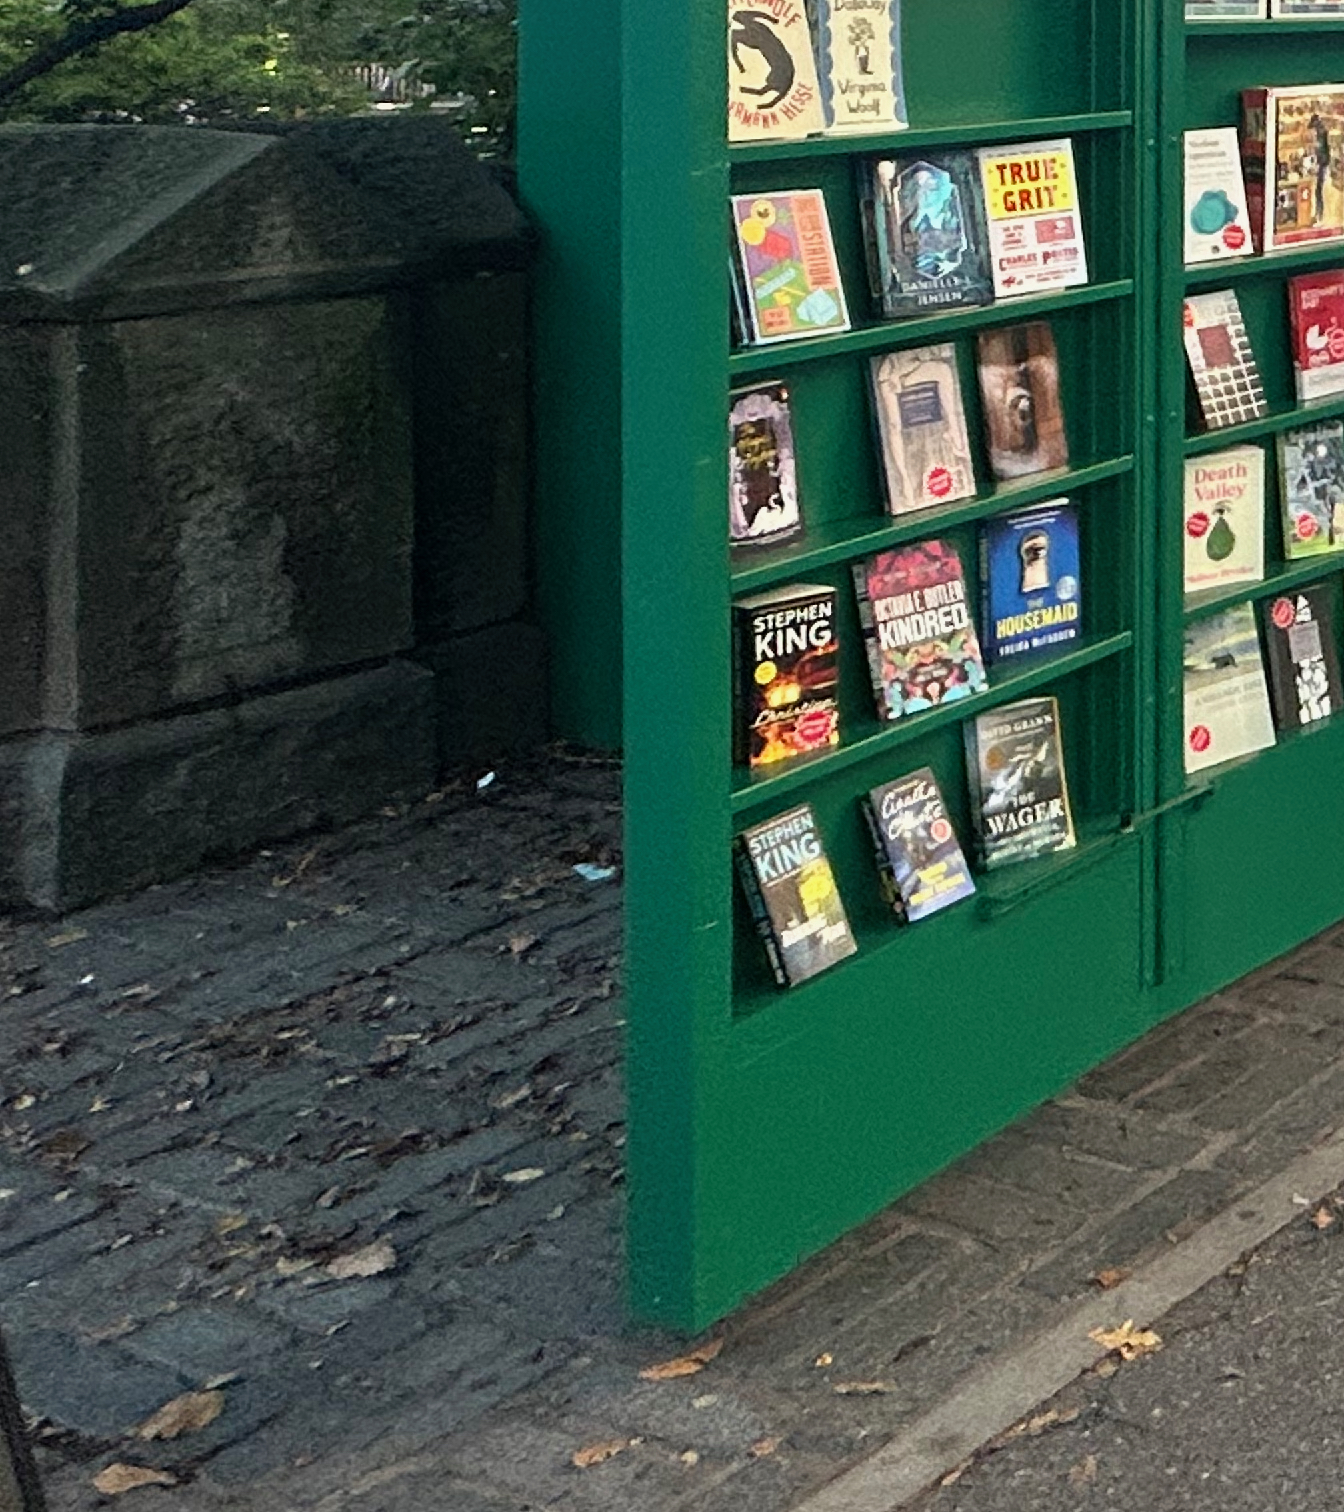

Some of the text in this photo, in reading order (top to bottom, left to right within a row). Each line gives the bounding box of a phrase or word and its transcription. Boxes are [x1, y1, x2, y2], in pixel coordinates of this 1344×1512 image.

[836, 78, 888, 98] Virginia
[846, 97, 881, 117] Woolf
[995, 156, 1059, 186] TRUE
[1002, 184, 1059, 213] GRIT
[1194, 462, 1248, 484] Death
[1194, 482, 1248, 501] Valley
[752, 601, 833, 634] STEPHEN
[877, 601, 970, 652] KINDRED
[995, 601, 1079, 639] HOUSEMAID
[755, 619, 833, 663] KING
[986, 796, 1066, 835] WAGER
[749, 811, 814, 855] STEPHEN
[755, 832, 821, 884] KING
